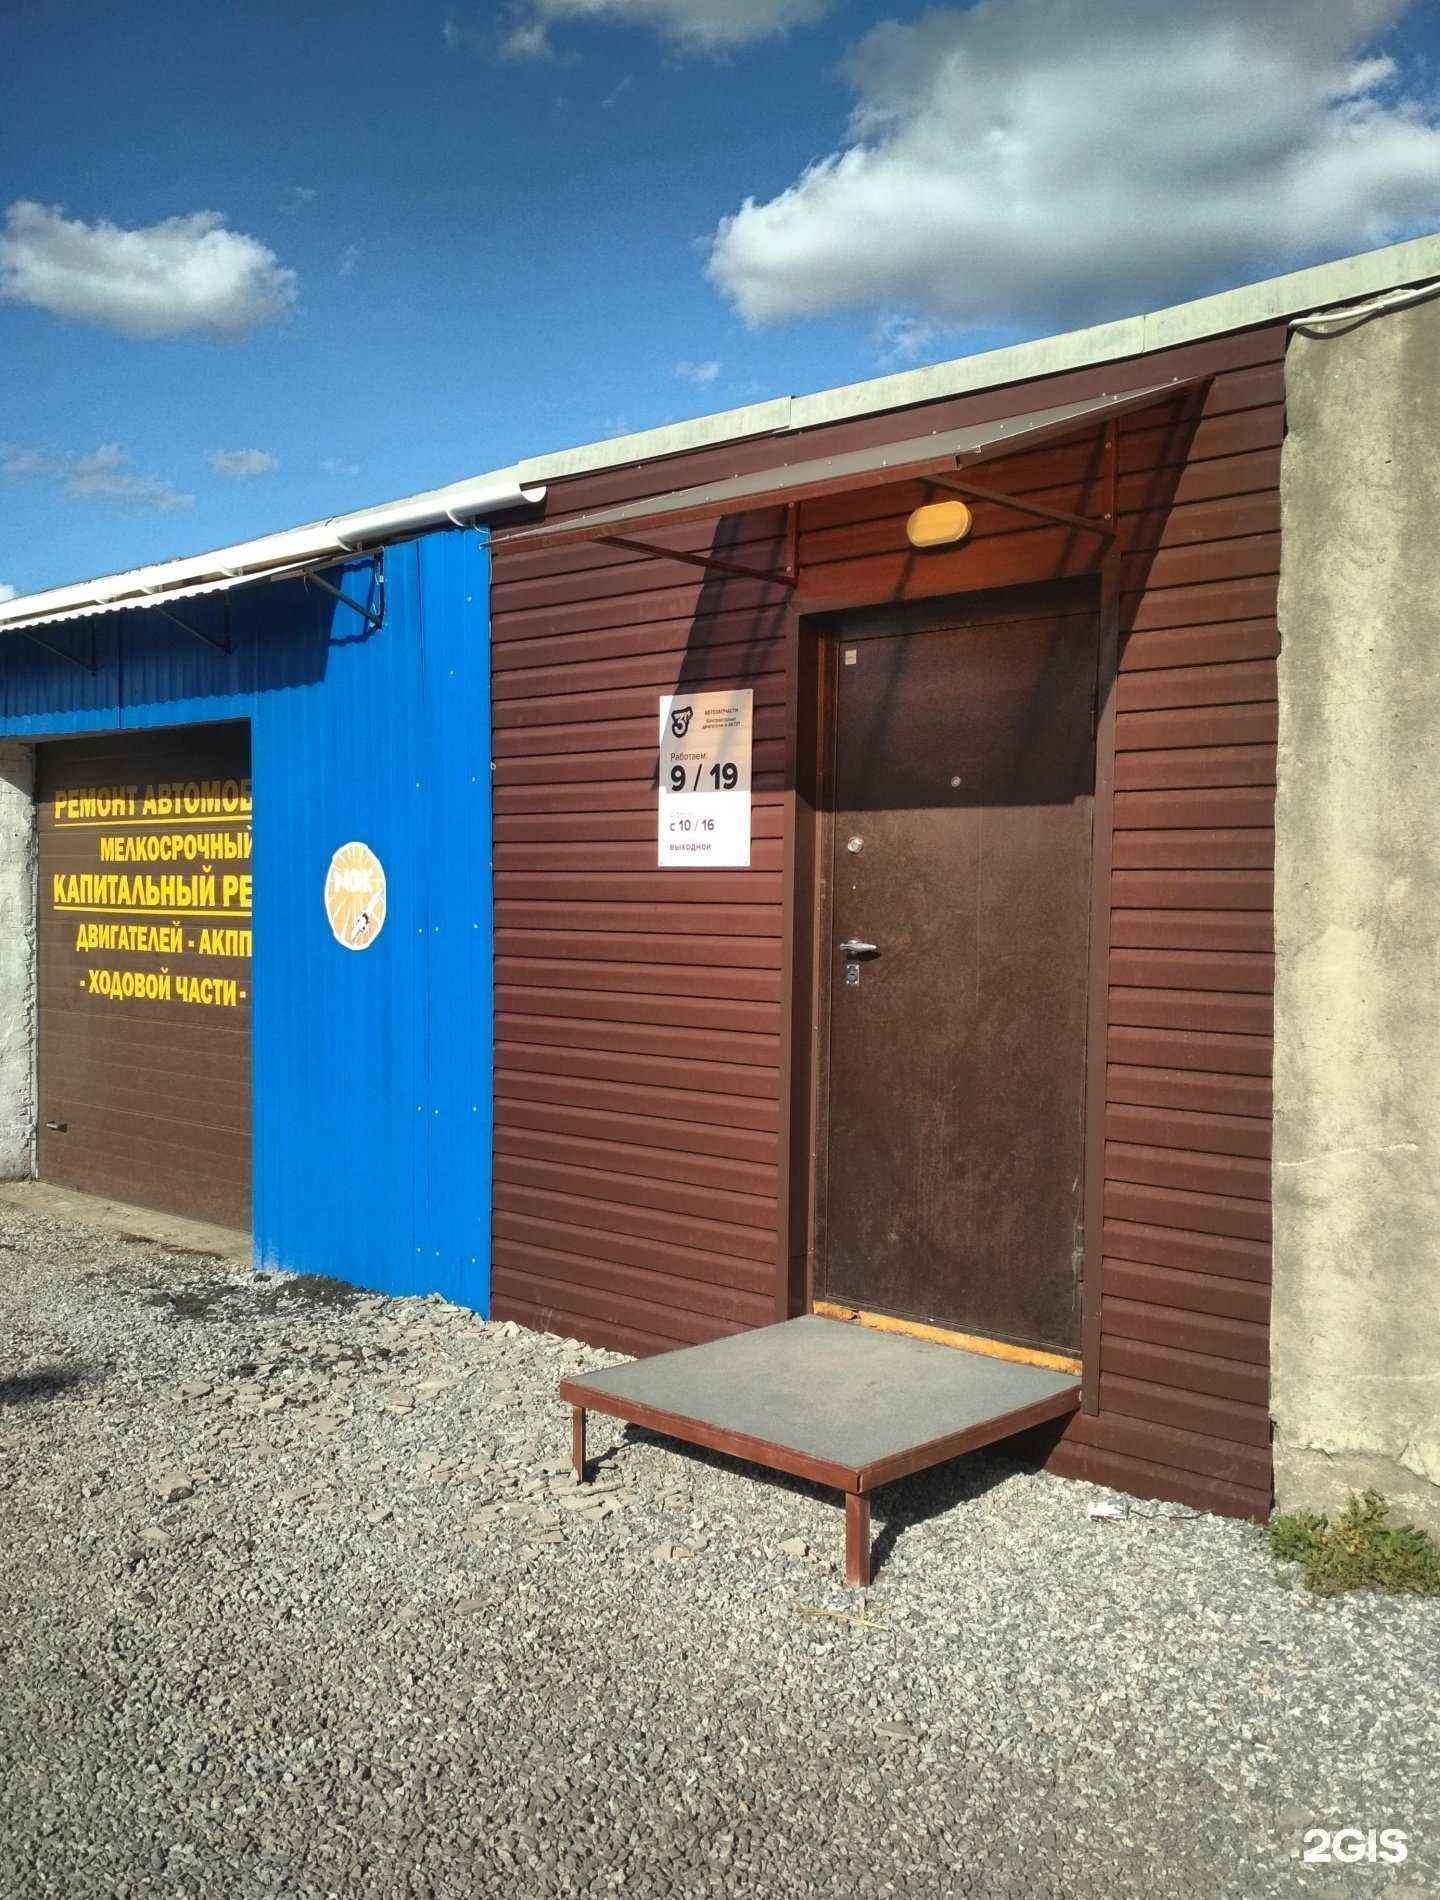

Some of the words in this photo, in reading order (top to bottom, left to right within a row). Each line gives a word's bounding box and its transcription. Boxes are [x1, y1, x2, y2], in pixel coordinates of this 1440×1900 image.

[670, 765, 686, 792] 9
[693, 763, 702, 791] /
[710, 762, 738, 790] 19
[54, 785, 137, 819] РЕМОНТ
[678, 819, 691, 831] 10
[702, 819, 714, 831] 16
[53, 864, 215, 907] КАПИТАЛЬНЫЙ
[223, 874, 252, 908] РЕ
[76, 920, 183, 953] ДВИГАТЕЛЕЙ
[199, 928, 252, 957] АКПП
[89, 967, 171, 1000] ХОДОВОЙ
[175, 977, 237, 1007] ЧАСТИ
